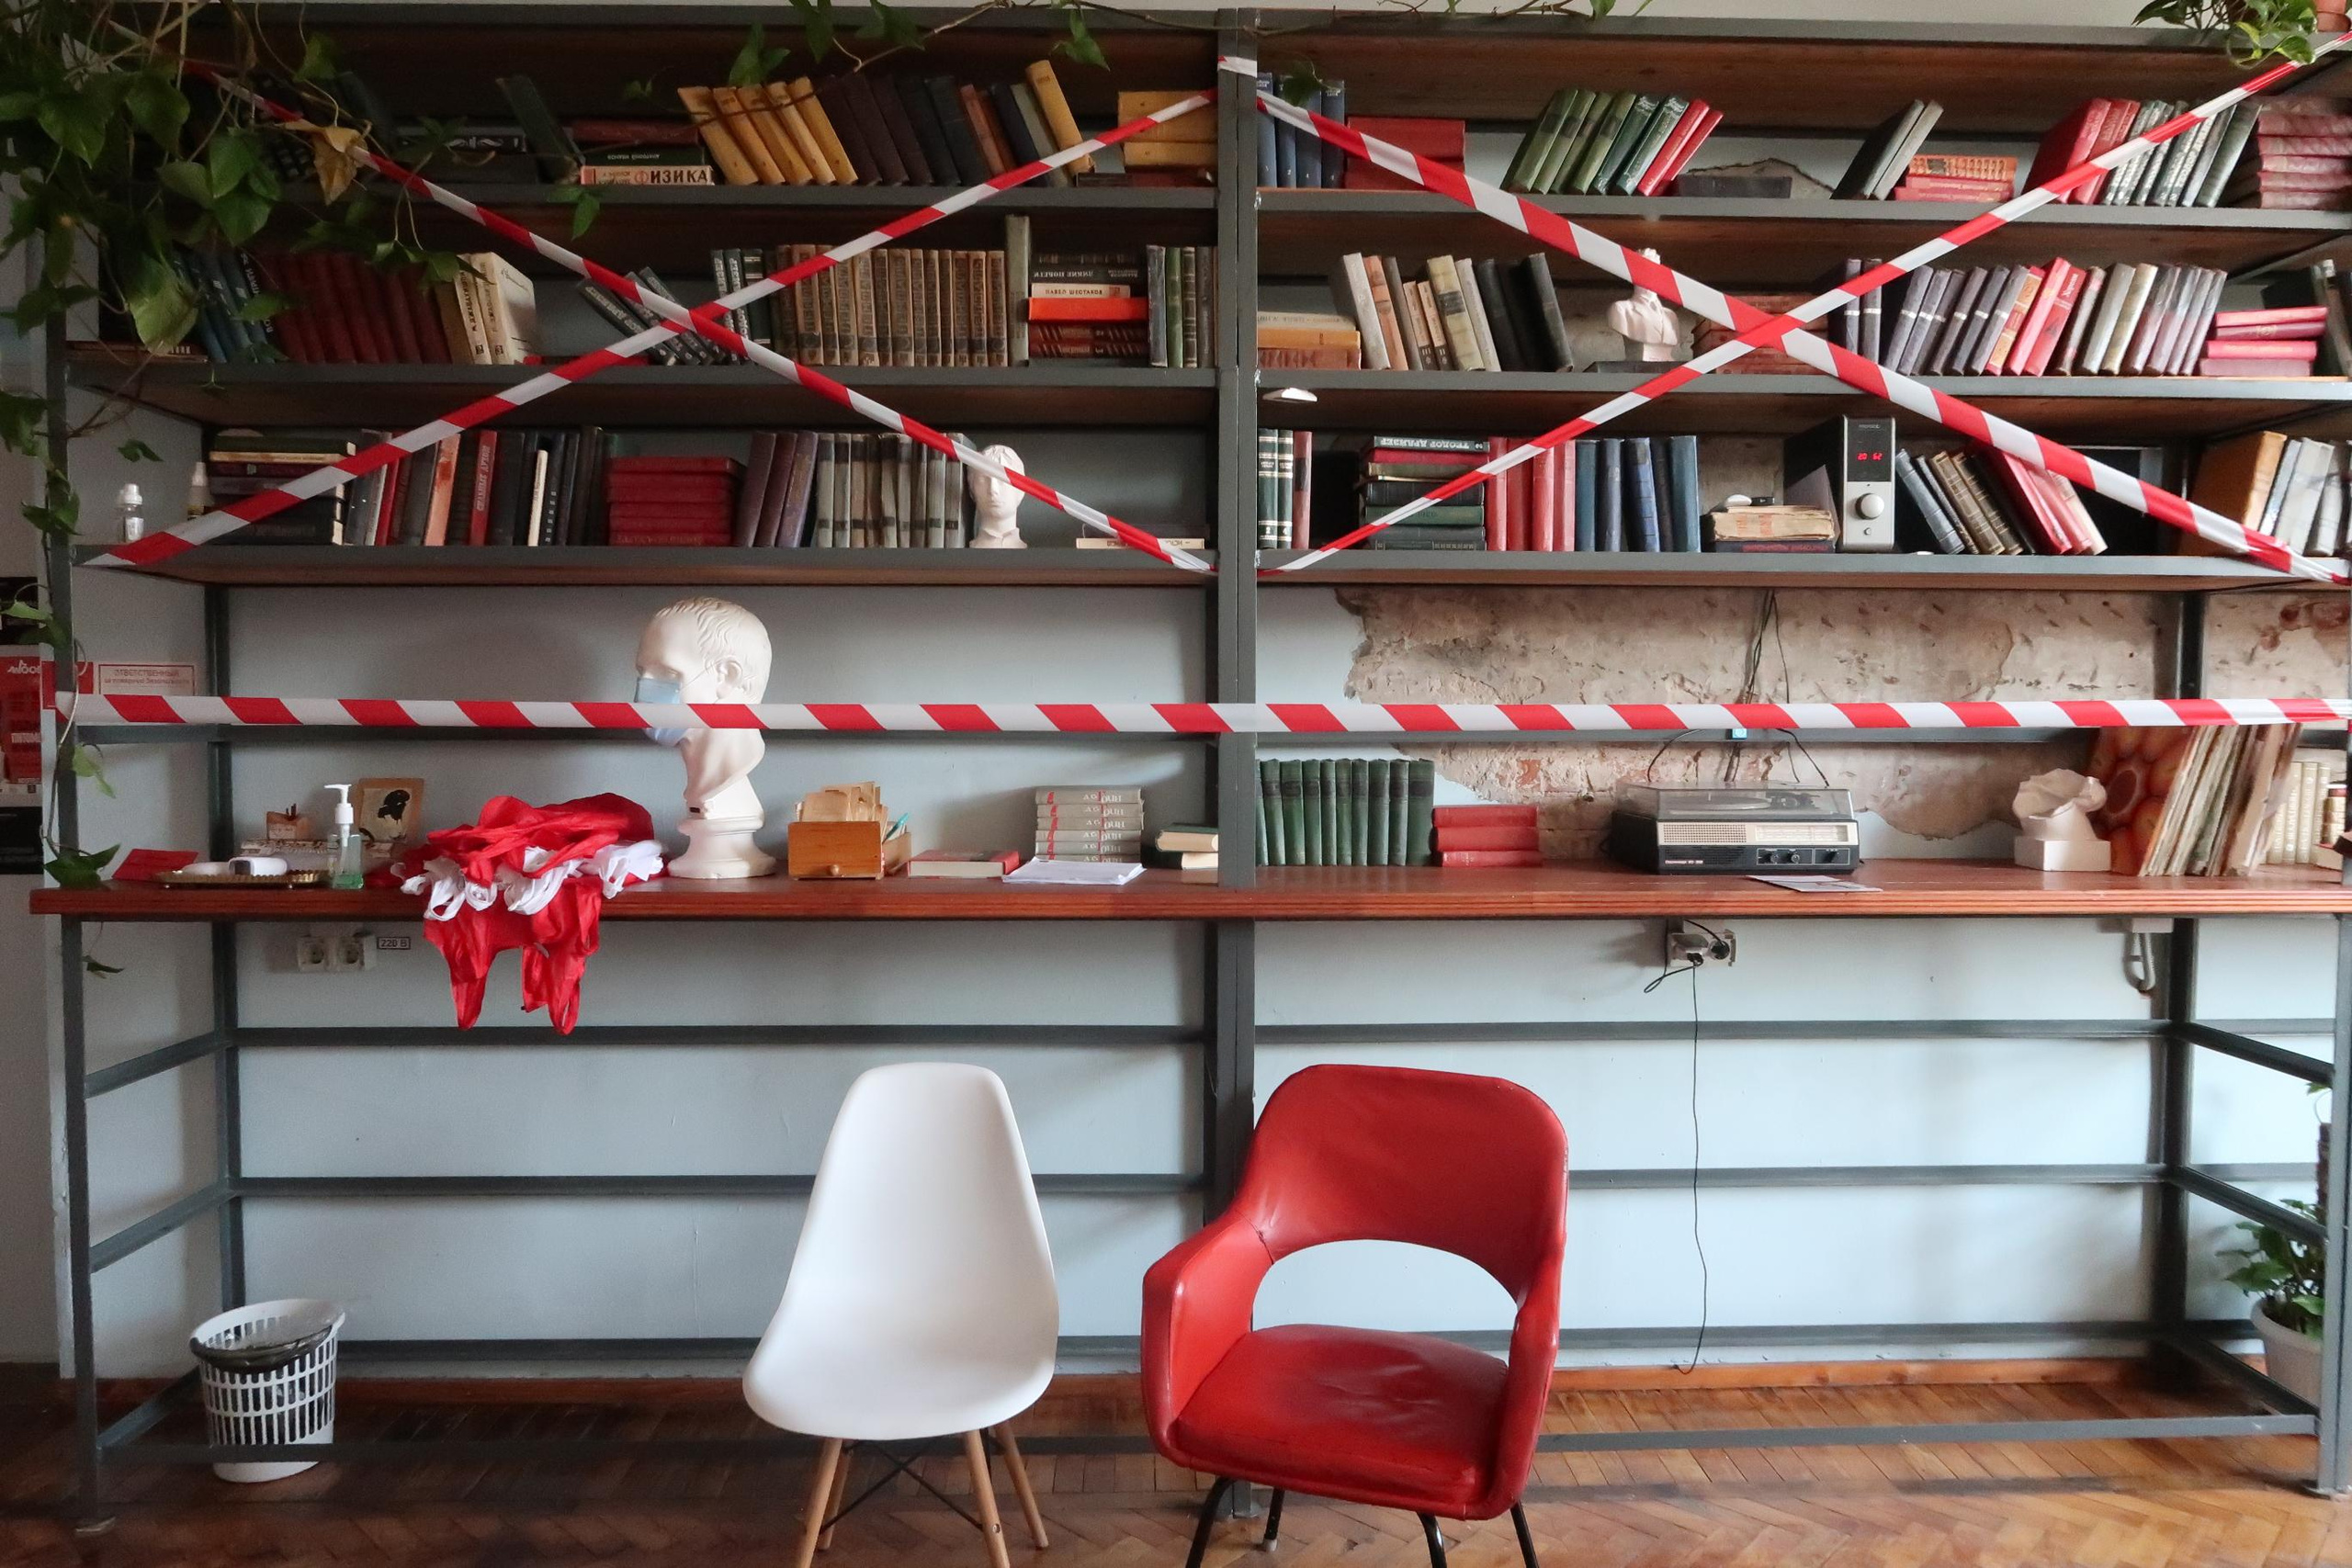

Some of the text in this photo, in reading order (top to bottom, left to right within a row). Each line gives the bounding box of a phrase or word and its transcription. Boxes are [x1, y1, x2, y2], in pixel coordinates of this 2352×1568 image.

[634, 169, 707, 184] ФИЗИКА
[1380, 437, 1428, 447] ДРАЙЗЕР
[1429, 441, 1470, 449] ТЕОДОР
[380, 939, 398, 947] 220
